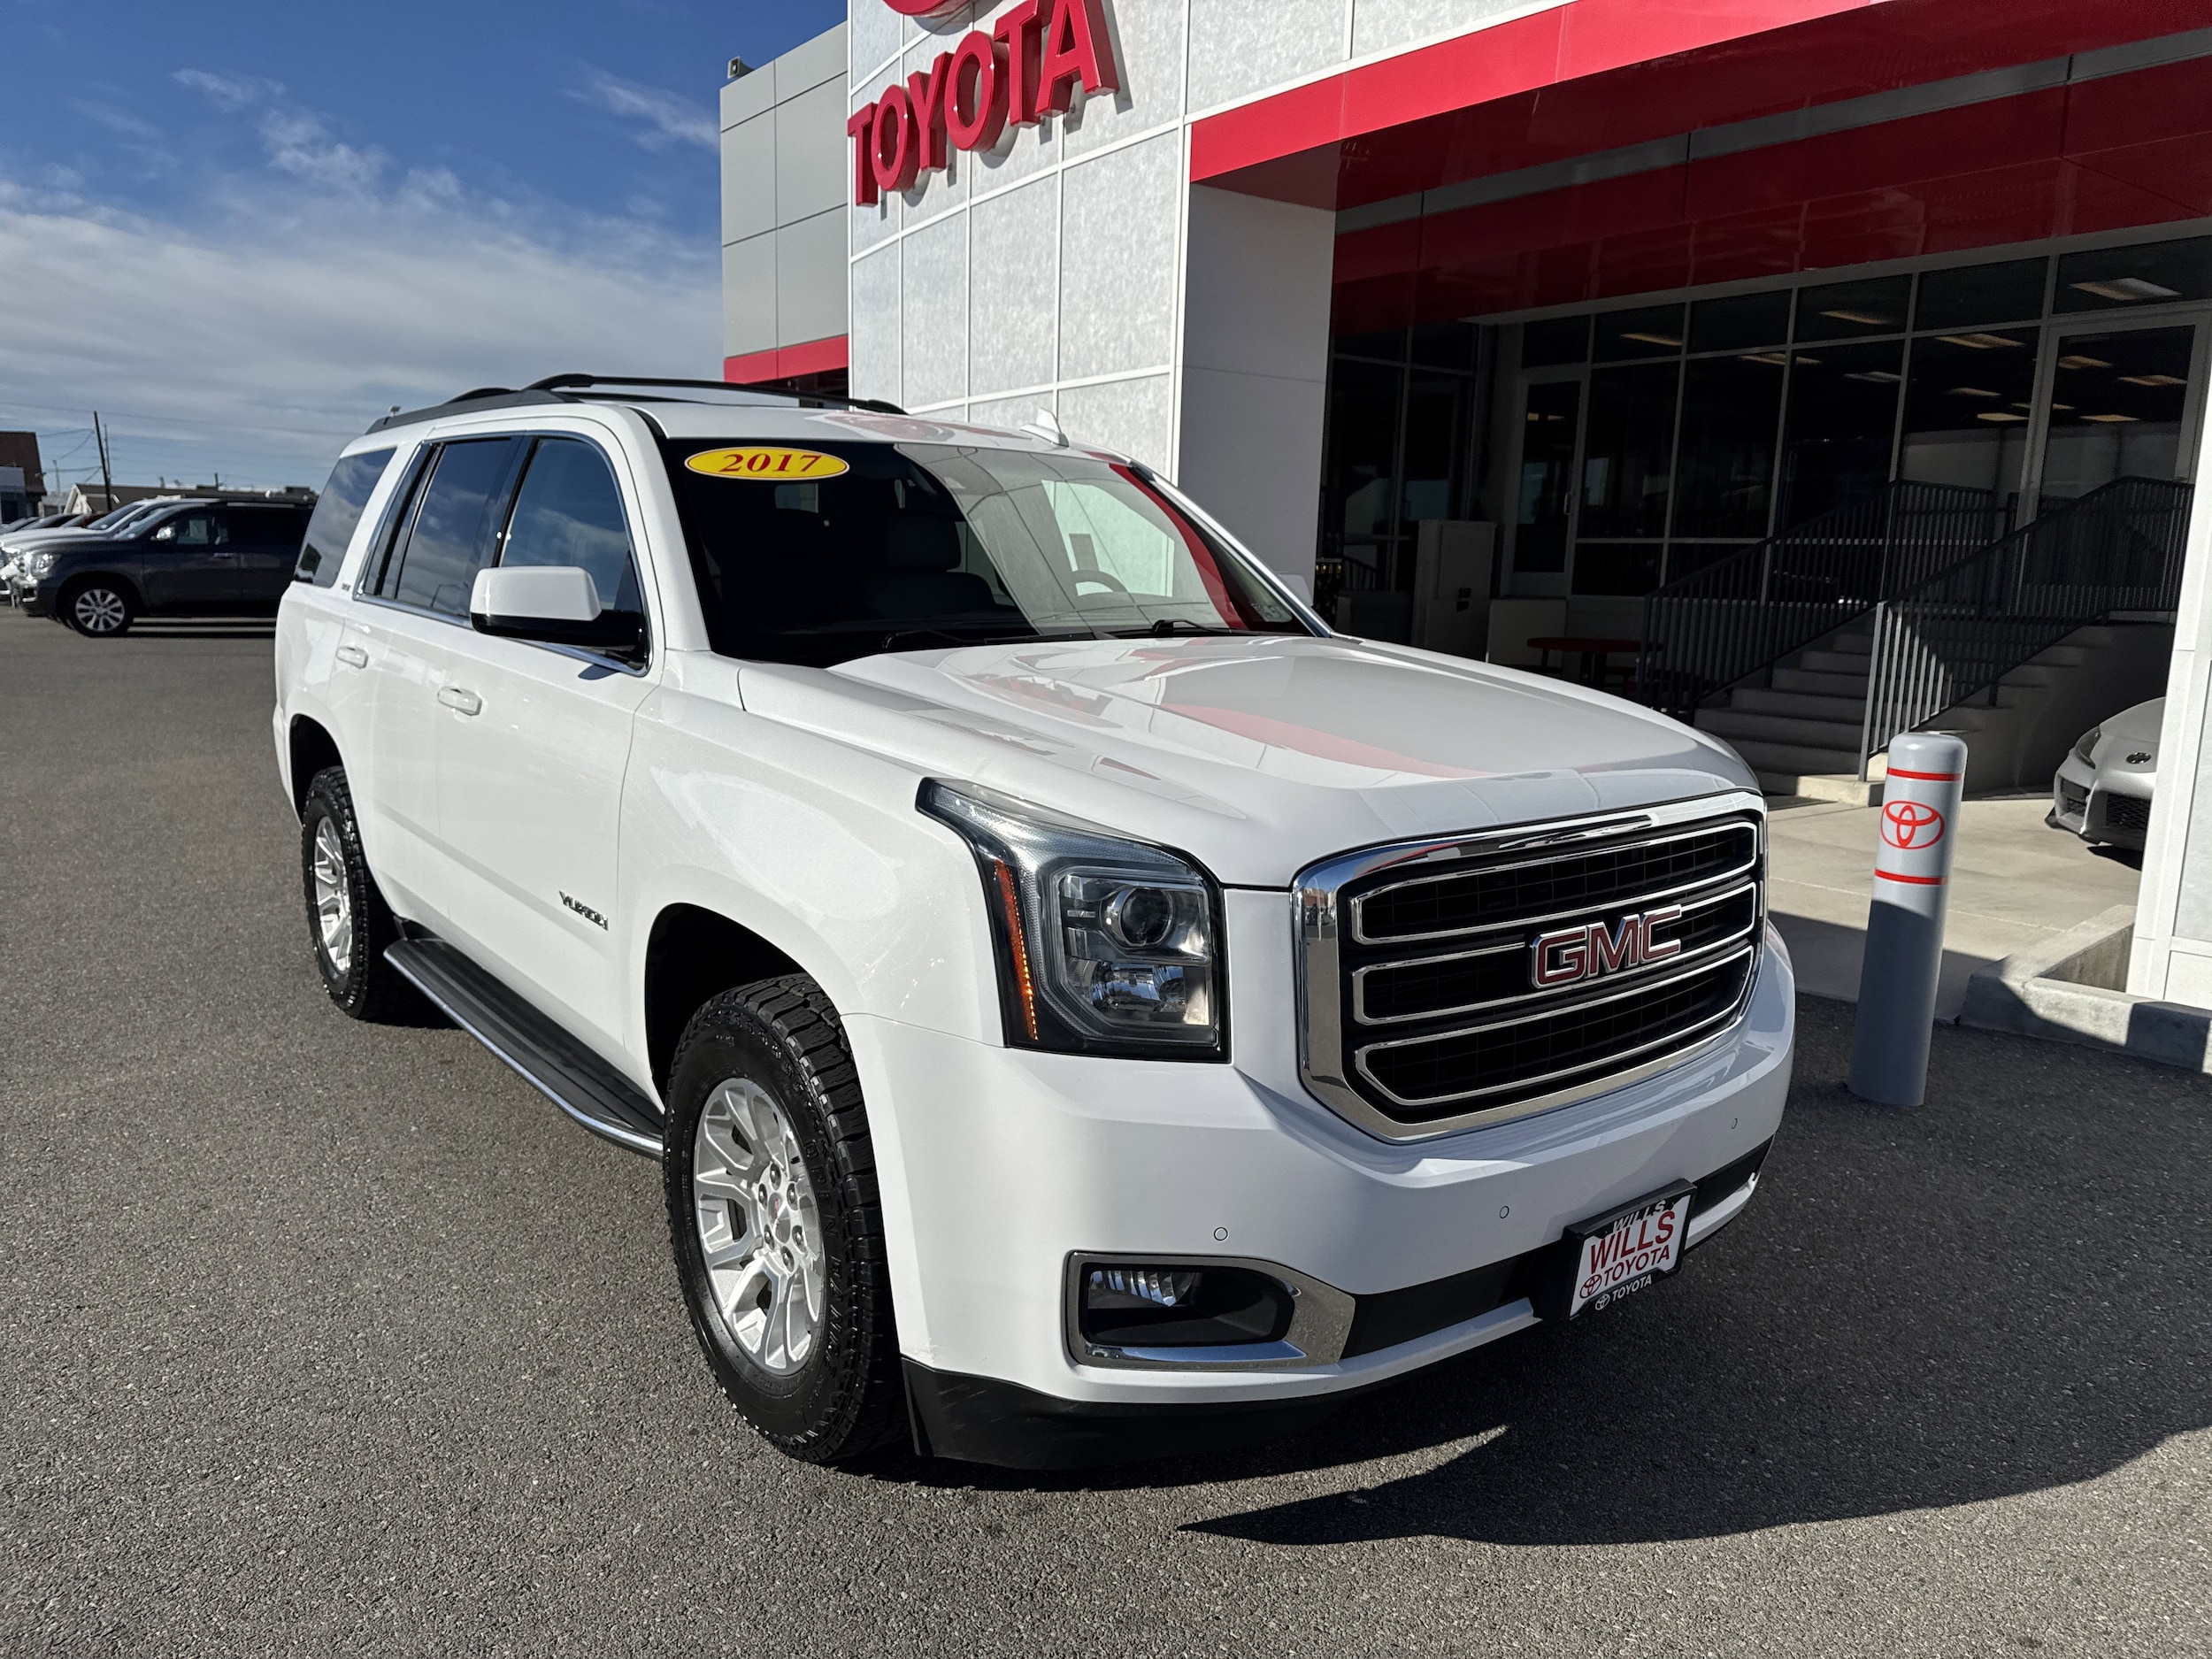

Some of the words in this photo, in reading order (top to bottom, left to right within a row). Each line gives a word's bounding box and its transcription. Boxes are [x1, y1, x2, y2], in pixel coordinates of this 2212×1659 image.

[848, 0, 1115, 207] TOYOTA
[718, 453, 823, 472] 2017
[558, 889, 609, 932] YUKON
[1531, 903, 1682, 989] GMC
[1612, 1199, 1666, 1233] WILLS
[1590, 1210, 1675, 1274] WILLS
[1604, 1244, 1671, 1286] TOYOTA
[1612, 1274, 1653, 1302] TOYOTA
